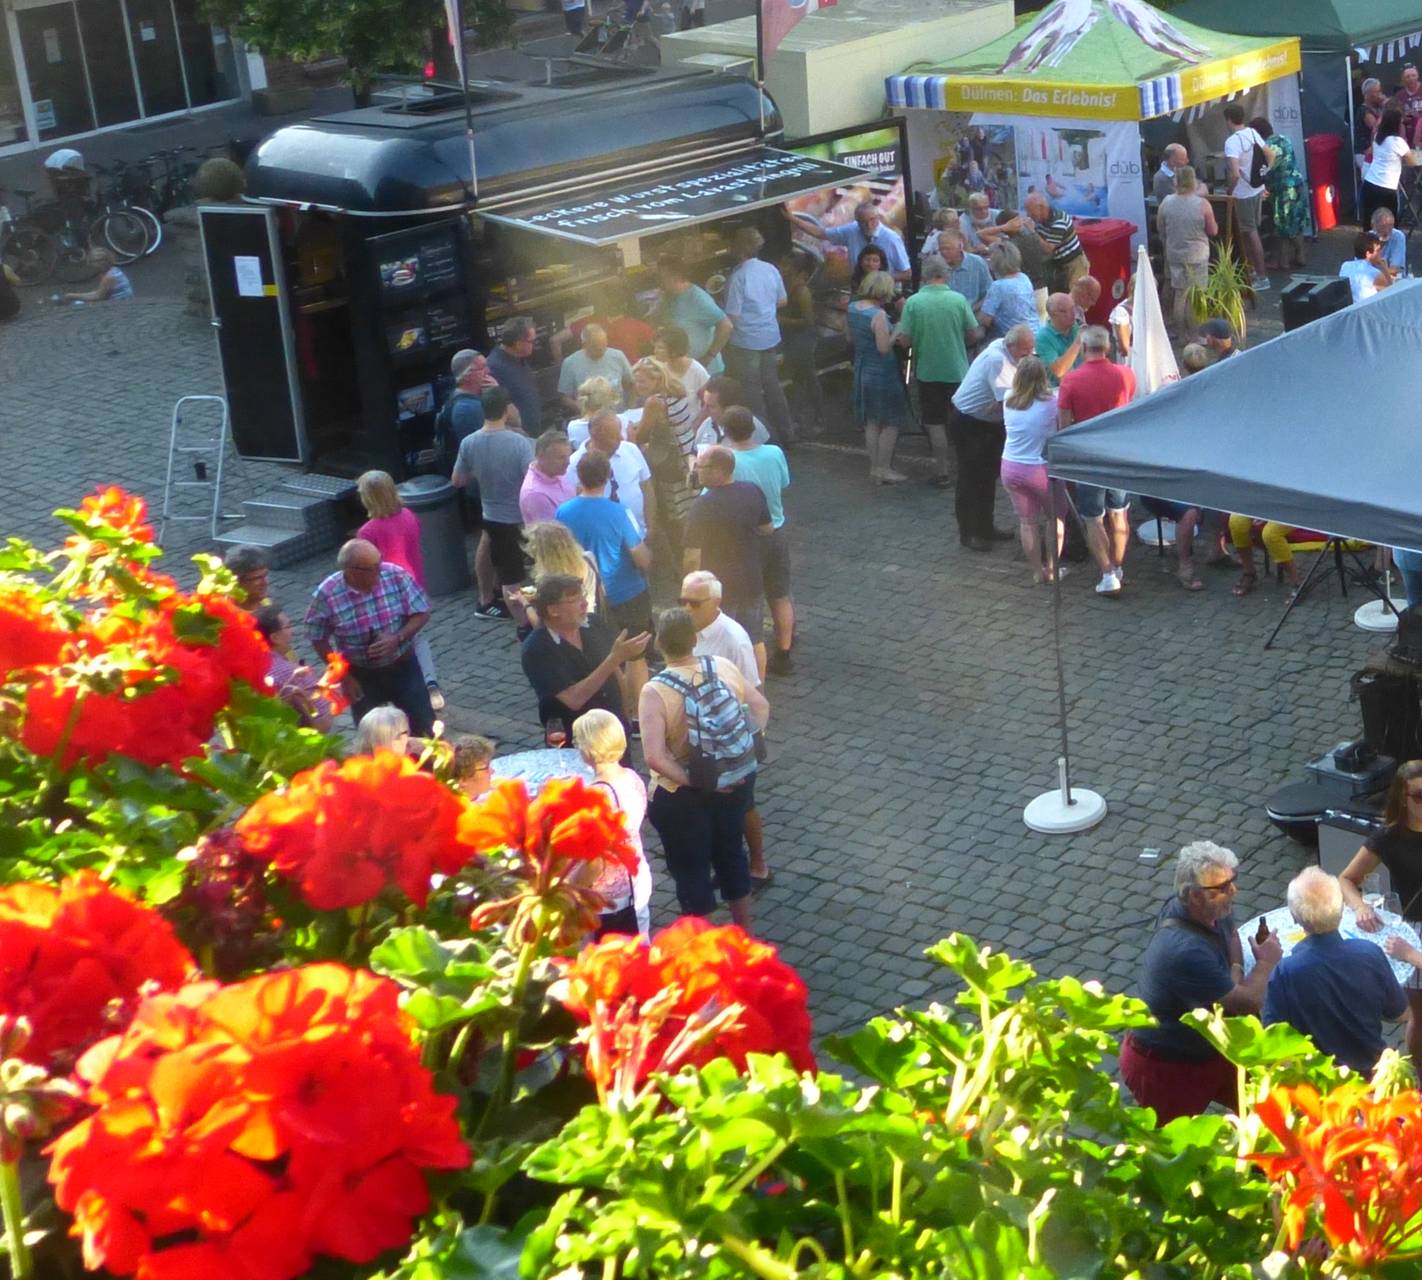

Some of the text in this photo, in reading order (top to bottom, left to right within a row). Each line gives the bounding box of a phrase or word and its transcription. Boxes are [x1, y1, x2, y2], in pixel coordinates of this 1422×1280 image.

[1023, 87, 1048, 104] Das
[1052, 90, 1117, 107] Erlebnis!
[843, 151, 878, 168] EINFACH
[515, 201, 609, 225] Leckere
[557, 207, 638, 228] frisch
[636, 196, 685, 210] vom
